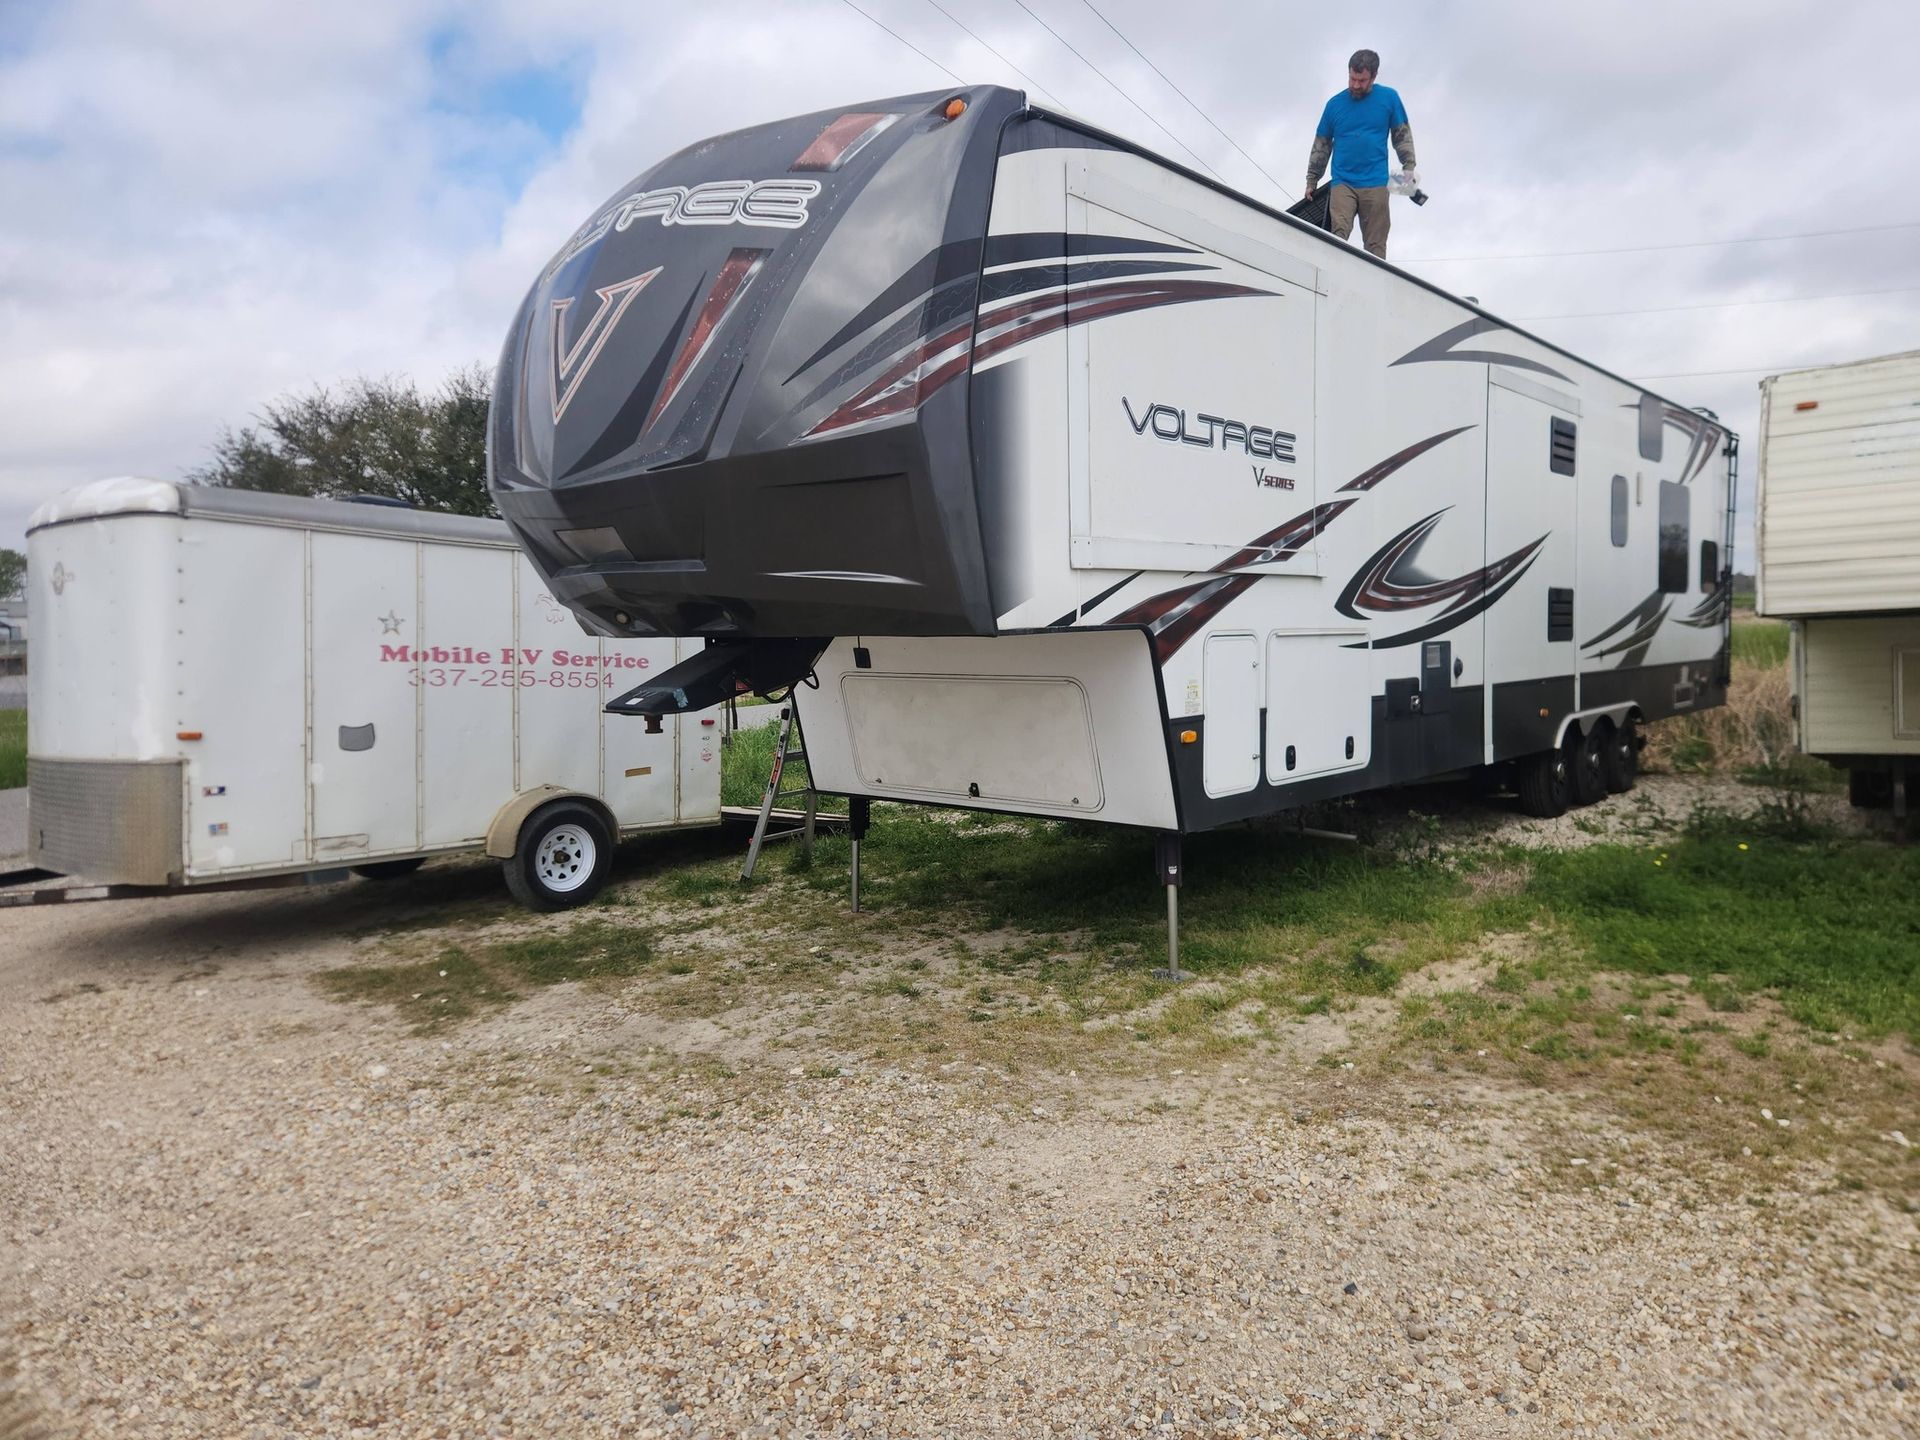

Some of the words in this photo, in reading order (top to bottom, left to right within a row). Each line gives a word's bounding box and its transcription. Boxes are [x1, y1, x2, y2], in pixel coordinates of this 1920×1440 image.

[1121, 396, 1297, 463] VOLTAGE
[380, 644, 491, 665] Mobile
[500, 648, 543, 665] RV
[552, 650, 650, 669] Service
[408, 668, 615, 688] 337-255-8554
